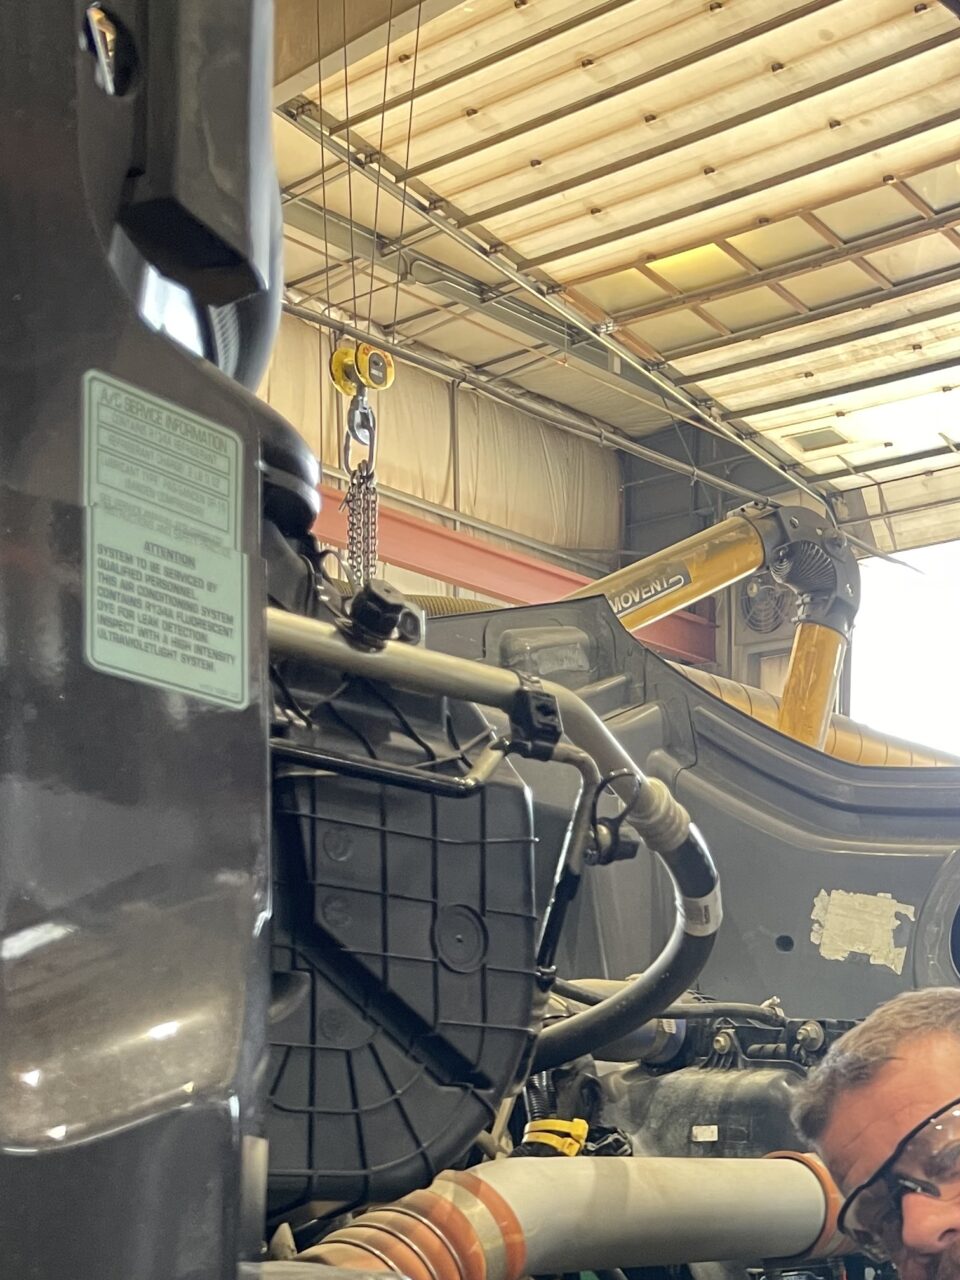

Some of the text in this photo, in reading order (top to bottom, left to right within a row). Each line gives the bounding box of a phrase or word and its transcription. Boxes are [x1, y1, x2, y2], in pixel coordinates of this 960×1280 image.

[101, 387, 228, 454] A/C SERVICE INFORMATION
[97, 543, 218, 593] SYSTEM TO BE SERVICED BY
[97, 557, 143, 582] QUALIFIED
[143, 540, 196, 569] ATTENTION
[97, 570, 234, 626] THIS AIR CONDITIONING SYSTEM
[97, 585, 233, 639] CONTAINS R134A FLUORESCENT
[97, 599, 115, 617] DYE
[117, 605, 135, 621] FOR
[137, 611, 159, 629] LEAK
[97, 613, 235, 666] INSPECT WITH A HIGH INTENSITY
